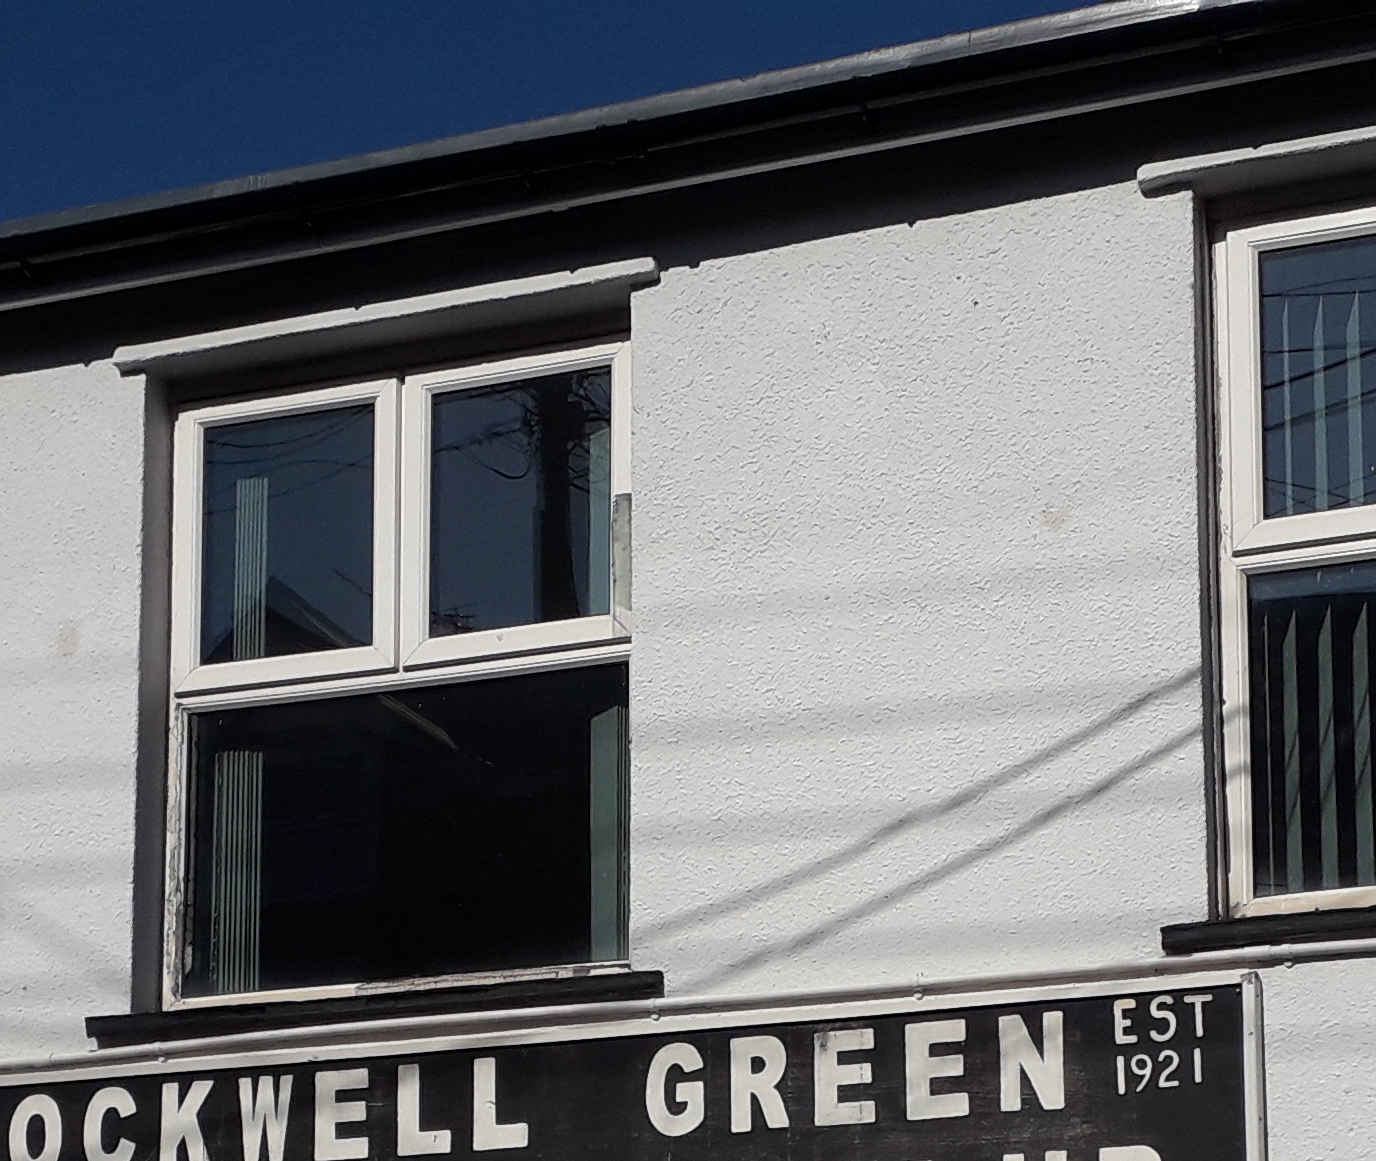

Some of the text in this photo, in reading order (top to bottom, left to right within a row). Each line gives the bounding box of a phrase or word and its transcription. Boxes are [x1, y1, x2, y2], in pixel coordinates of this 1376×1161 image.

[1112, 994, 1213, 1046] EST
[645, 1010, 1066, 1137] GREEN
[1116, 1047, 1204, 1095] 1921
